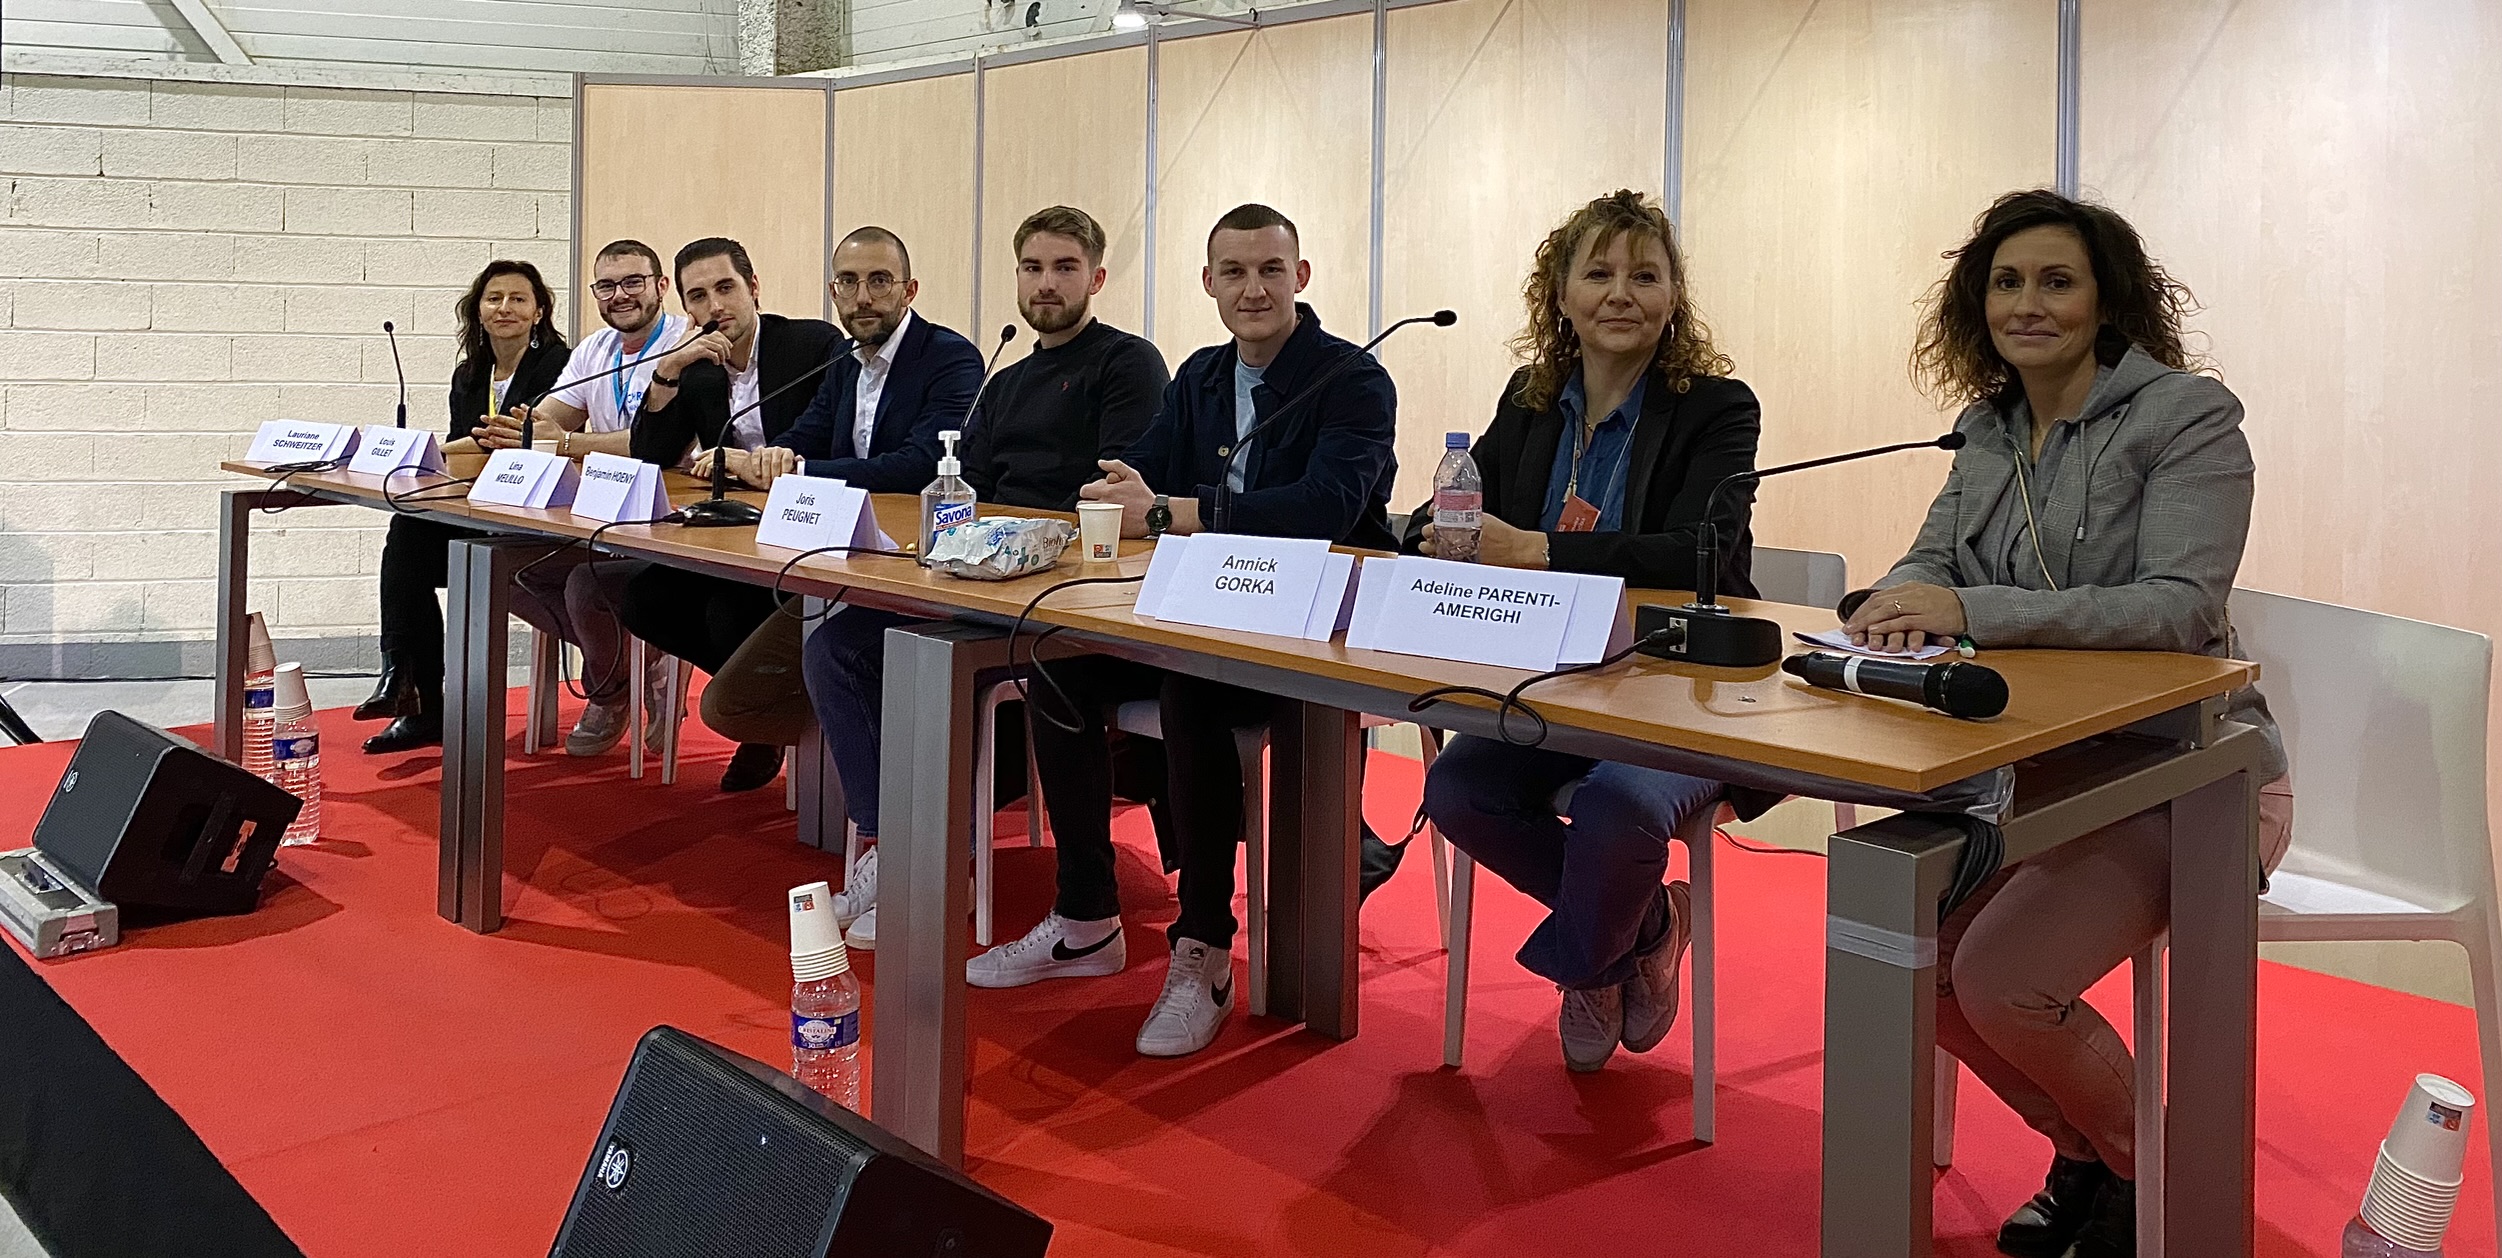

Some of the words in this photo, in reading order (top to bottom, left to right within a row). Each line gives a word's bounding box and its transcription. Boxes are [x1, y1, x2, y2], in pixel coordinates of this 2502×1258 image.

[287, 429, 320, 440] Lauriane
[379, 437, 396, 446] Louis
[272, 439, 323, 451] SCHWEITZER
[371, 447, 393, 458] GILLET
[508, 460, 523, 471] Lina
[585, 465, 612, 481] Benjamin
[495, 472, 525, 485] MELILLO
[795, 492, 816, 506] Joris
[781, 508, 821, 525] PEUGNET
[935, 506, 972, 525] Savona
[1222, 555, 1278, 572] Annick
[1215, 575, 1274, 595] GORKA
[1411, 578, 1473, 598] Adeline
[1478, 586, 1561, 608] PARENTI-
[1433, 602, 1522, 624] AMERIGHI
[596, 1141, 617, 1178] YAMAHA
